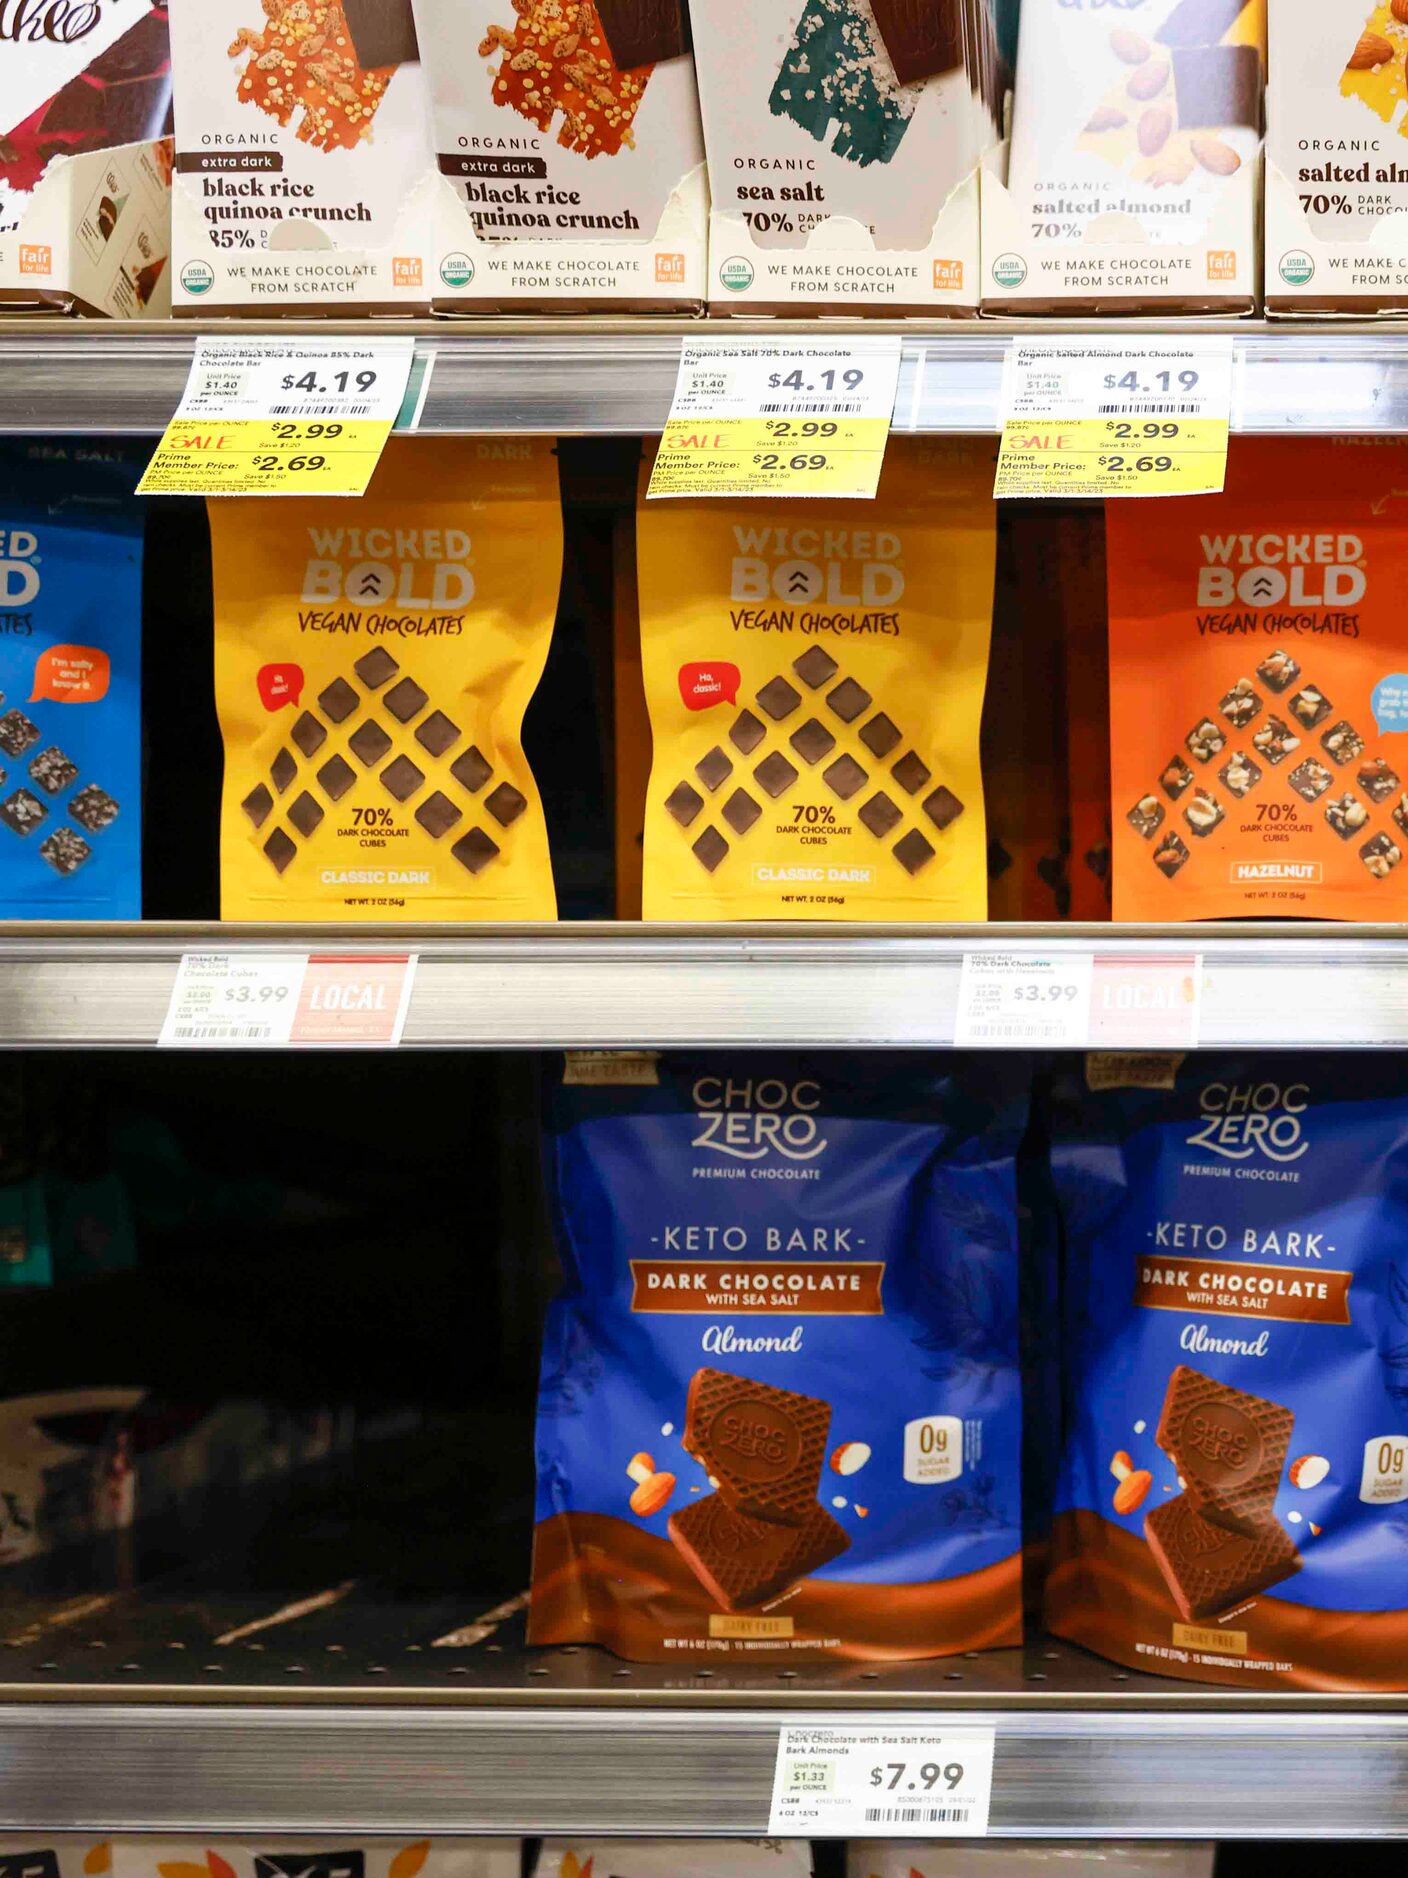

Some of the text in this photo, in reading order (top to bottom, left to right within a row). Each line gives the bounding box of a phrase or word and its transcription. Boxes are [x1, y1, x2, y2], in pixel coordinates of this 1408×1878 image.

[1298, 140, 1380, 151] ORGANIC
[461, 161, 536, 174] extra dark
[1299, 163, 1370, 184] salted
[203, 178, 314, 197] black rice
[466, 182, 581, 205] black rice
[737, 181, 825, 201] sea salt
[1299, 194, 1352, 215] 70%
[1358, 196, 1392, 204] DARK
[204, 200, 283, 223] quinoa
[470, 207, 639, 230] quinoa crunch
[488, 260, 640, 271] WE MAKE CHOCOLATE
[1328, 257, 1349, 268] WE
[1354, 257, 1393, 268] MAKE
[511, 277, 617, 287] FROM SCRATCH
[1352, 274, 1390, 284] FROM
[281, 370, 377, 393] $4.19
[768, 369, 864, 391] $4.19
[1103, 370, 1199, 392] $4.19
[271, 422, 343, 439] $2.99
[765, 421, 837, 437] $2.99
[1106, 422, 1179, 439] $2.99
[169, 435, 236, 449] SALE
[667, 435, 730, 449] SALE
[252, 455, 326, 471] $2.69
[753, 454, 827, 470] $2.69
[1098, 455, 1172, 472] $2.69
[307, 528, 472, 560] WICKED
[733, 526, 901, 560] WICKED
[1200, 534, 1363, 564] WICKED
[301, 560, 475, 610] BOLD
[731, 557, 905, 607] BOLD
[1197, 566, 1367, 607] BOLD
[299, 611, 464, 637] VEGAN CHOCOLATES
[730, 610, 900, 635] VEGAN CHOCOLATES
[1196, 613, 1360, 637] VEGAN CHOCOLATES
[352, 808, 393, 826] 70%
[792, 806, 835, 824] 70%
[1255, 803, 1298, 822] 70%
[776, 826, 851, 835] DARK CHOCOLATE
[1240, 823, 1313, 832] DARK CHOCOLATE
[800, 836, 827, 845] CUBES
[1263, 833, 1290, 843] CUBES
[320, 870, 430, 885] CLASSIC DARK
[757, 868, 871, 882] CLASSIC DARK
[1238, 864, 1314, 879] HAZELNUT
[224, 987, 289, 1002] $3.99
[310, 985, 387, 1010] LOCAL
[1014, 985, 1078, 1002] $3.99
[692, 1078, 821, 1111] CHOC
[1200, 1083, 1310, 1112] CHOC
[691, 1113, 828, 1160] ZERO
[1186, 1115, 1309, 1162] ZERO
[692, 1168, 820, 1180] PREMIUM CHOCOLATE
[1183, 1165, 1300, 1183] PREMIUM CHOCOLATE
[648, 1274, 861, 1291] DARK CHOCOLATE
[1142, 1269, 1329, 1300] DARK CHOCOLATE
[706, 1294, 799, 1306] WITH SEA SALT
[1187, 1292, 1269, 1310] WITH SEA SALT
[701, 1326, 804, 1356] Almond
[1180, 1324, 1269, 1358] Almond
[920, 1423, 948, 1454] 0g
[787, 1736, 808, 1744] Dark
[811, 1736, 857, 1744] Chocolate
[860, 1736, 879, 1744] with
[882, 1736, 898, 1744] Sea
[900, 1736, 918, 1744] Salt
[793, 1772, 824, 1781] $1.33
[870, 1763, 964, 1790] $7.99
